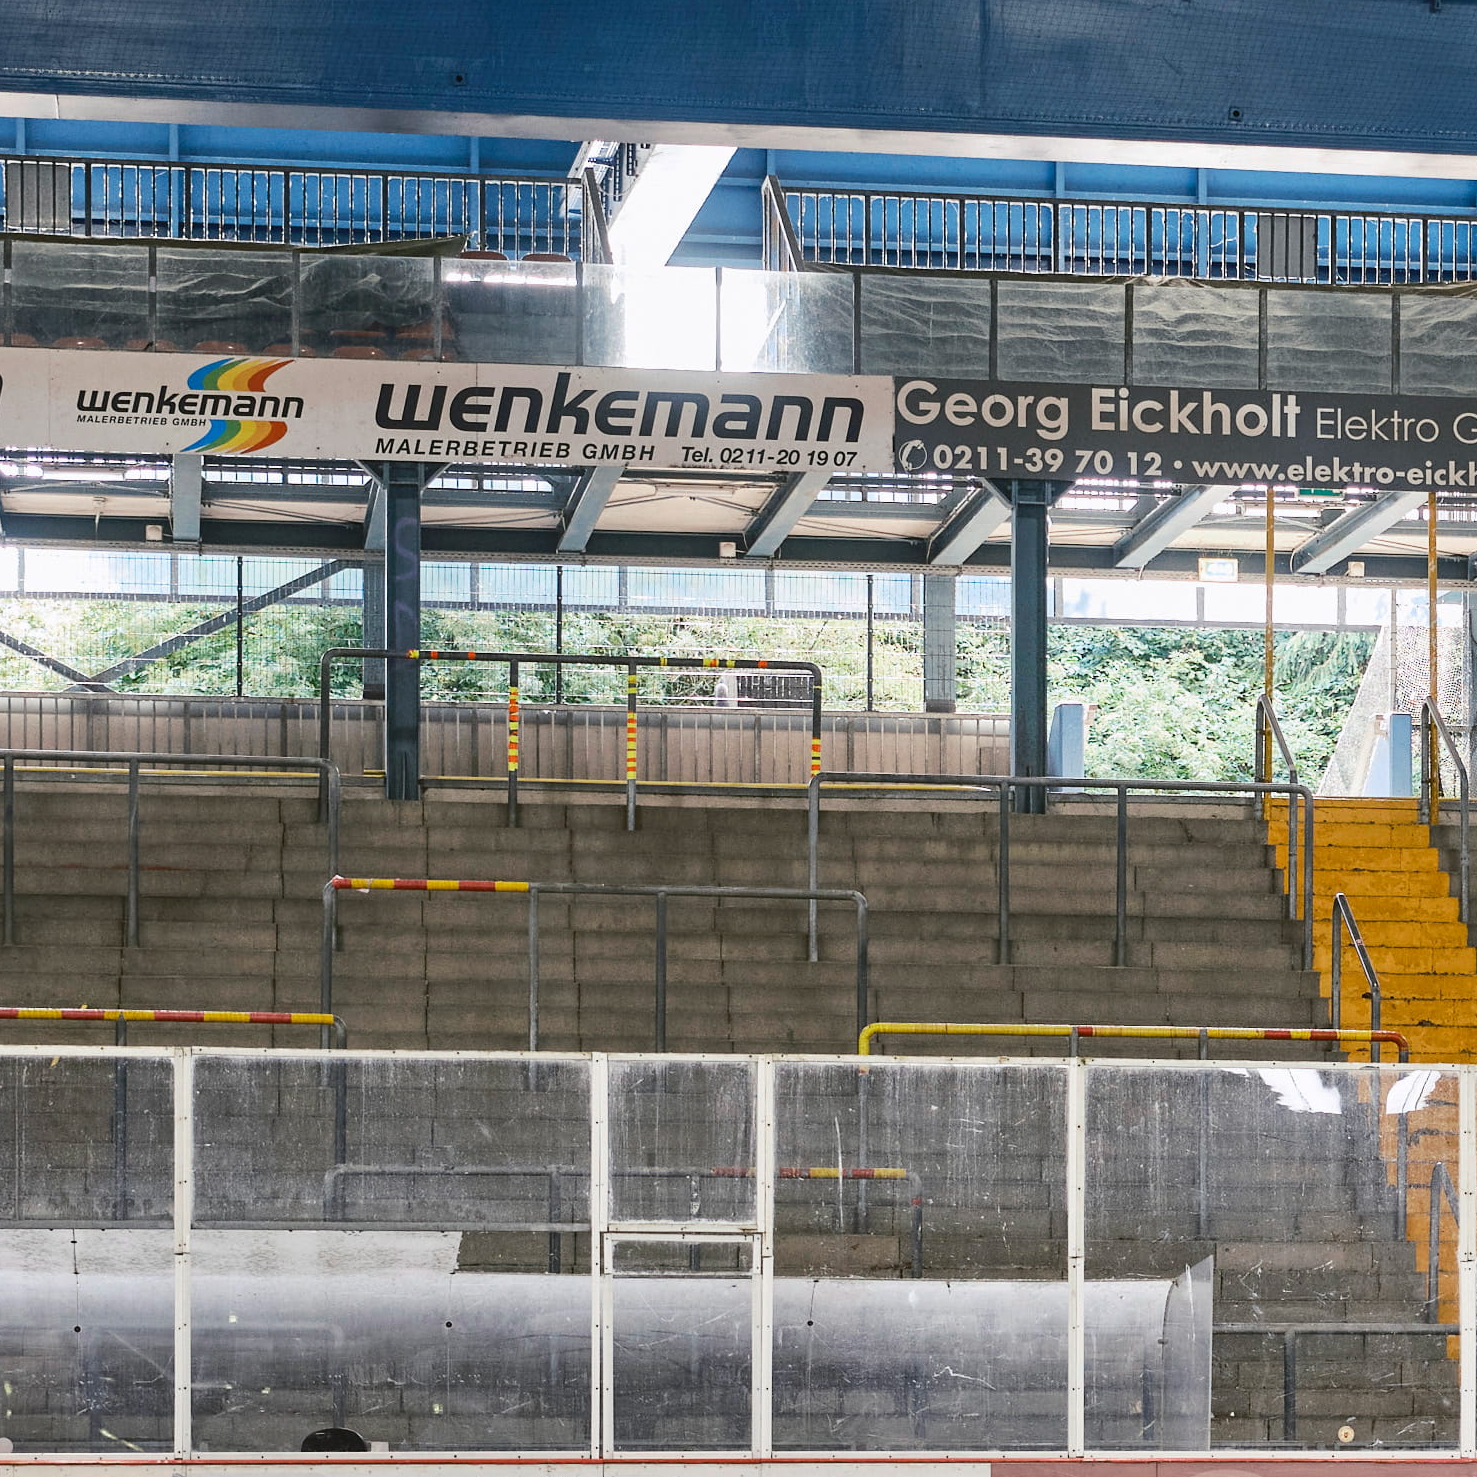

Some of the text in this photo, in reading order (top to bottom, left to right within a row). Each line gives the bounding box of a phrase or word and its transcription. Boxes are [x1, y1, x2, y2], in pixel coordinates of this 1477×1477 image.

[76, 385, 305, 418] wenkemann
[374, 372, 865, 443] wenkemann
[896, 380, 1069, 441] Georg
[1091, 387, 1301, 438] Eickholt
[1315, 407, 1440, 443] Elektro
[76, 414, 207, 426] MALERBETRIEB GMBH
[375, 437, 571, 458] MALERBETRIEB
[582, 443, 656, 461] GMBH
[680, 446, 714, 464] Tel.
[719, 447, 801, 466] 0211-20
[933, 444, 1064, 473] 0211-39
[1075, 450, 1114, 475] 70
[1127, 451, 1163, 477] 12
